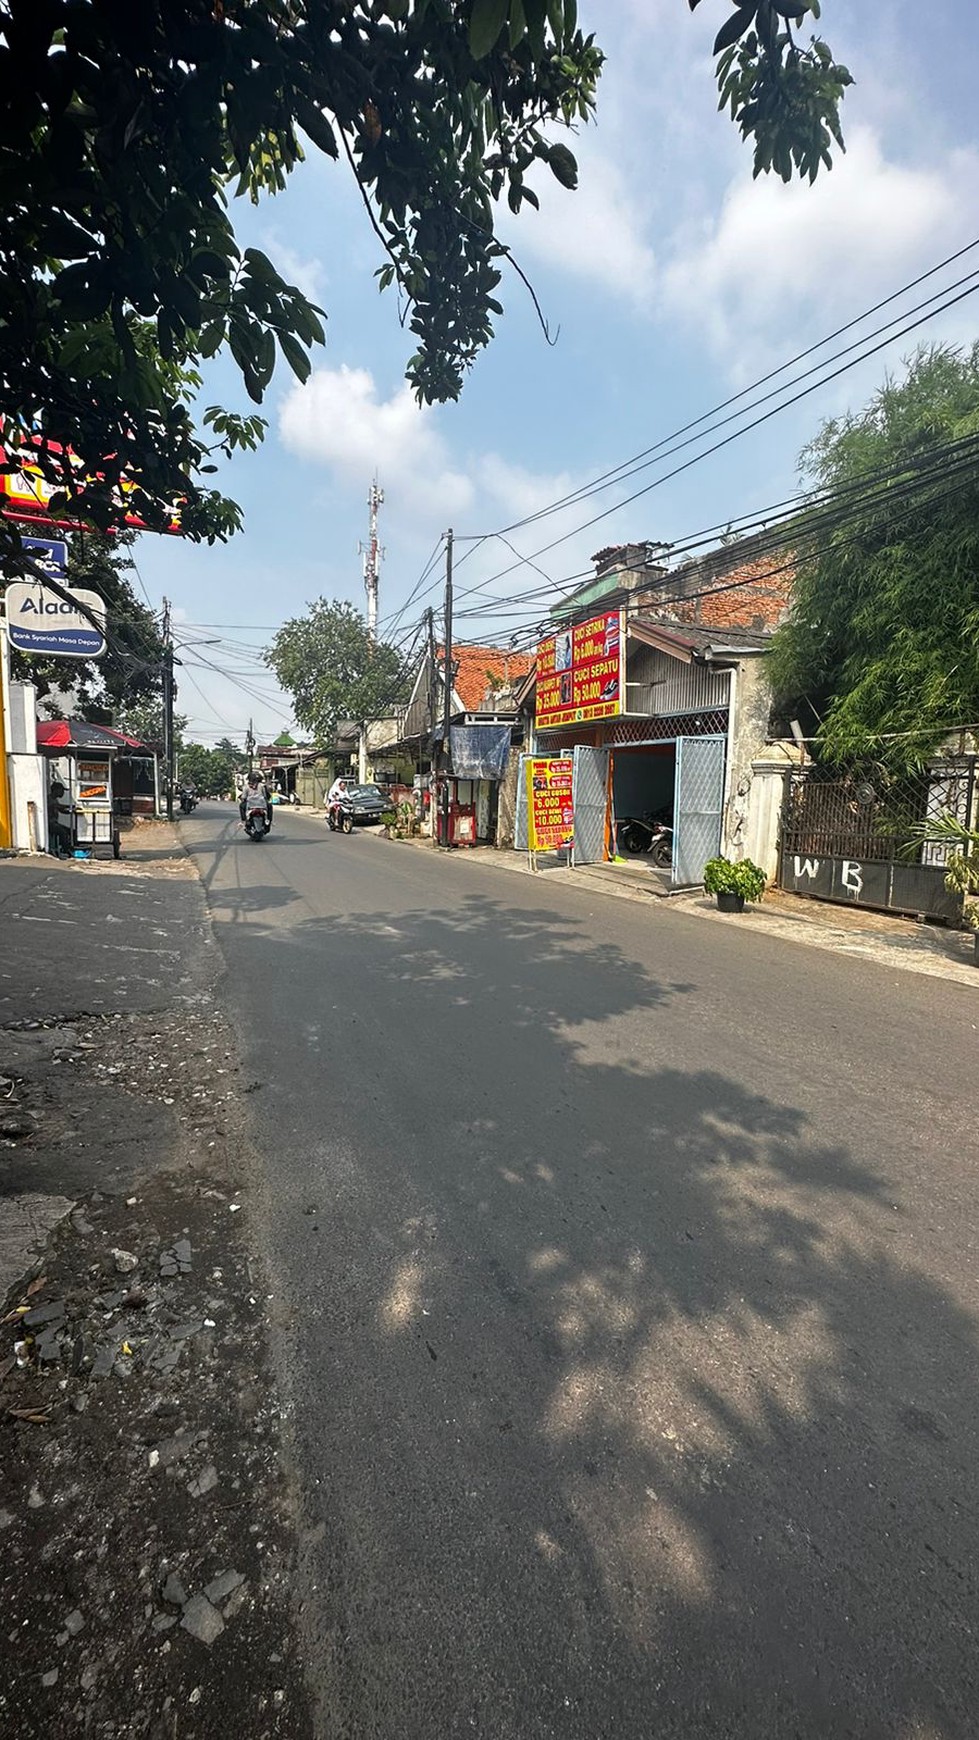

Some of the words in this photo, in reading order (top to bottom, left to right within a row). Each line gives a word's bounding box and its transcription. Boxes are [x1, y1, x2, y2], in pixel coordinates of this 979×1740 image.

[12, 632, 31, 640] Bank
[32, 633, 58, 644] Syariah
[58, 636, 77, 645] Masa
[77, 638, 101, 648] Depan
[574, 668, 590, 683] CUCI
[591, 658, 618, 677] SEPATU
[574, 686, 581, 706] Rp
[582, 680, 601, 701] 50.000
[536, 790, 550, 798] CUCI
[538, 815, 562, 826] 10.000
[794, 855, 820, 878] W
[841, 860, 864, 893] B
